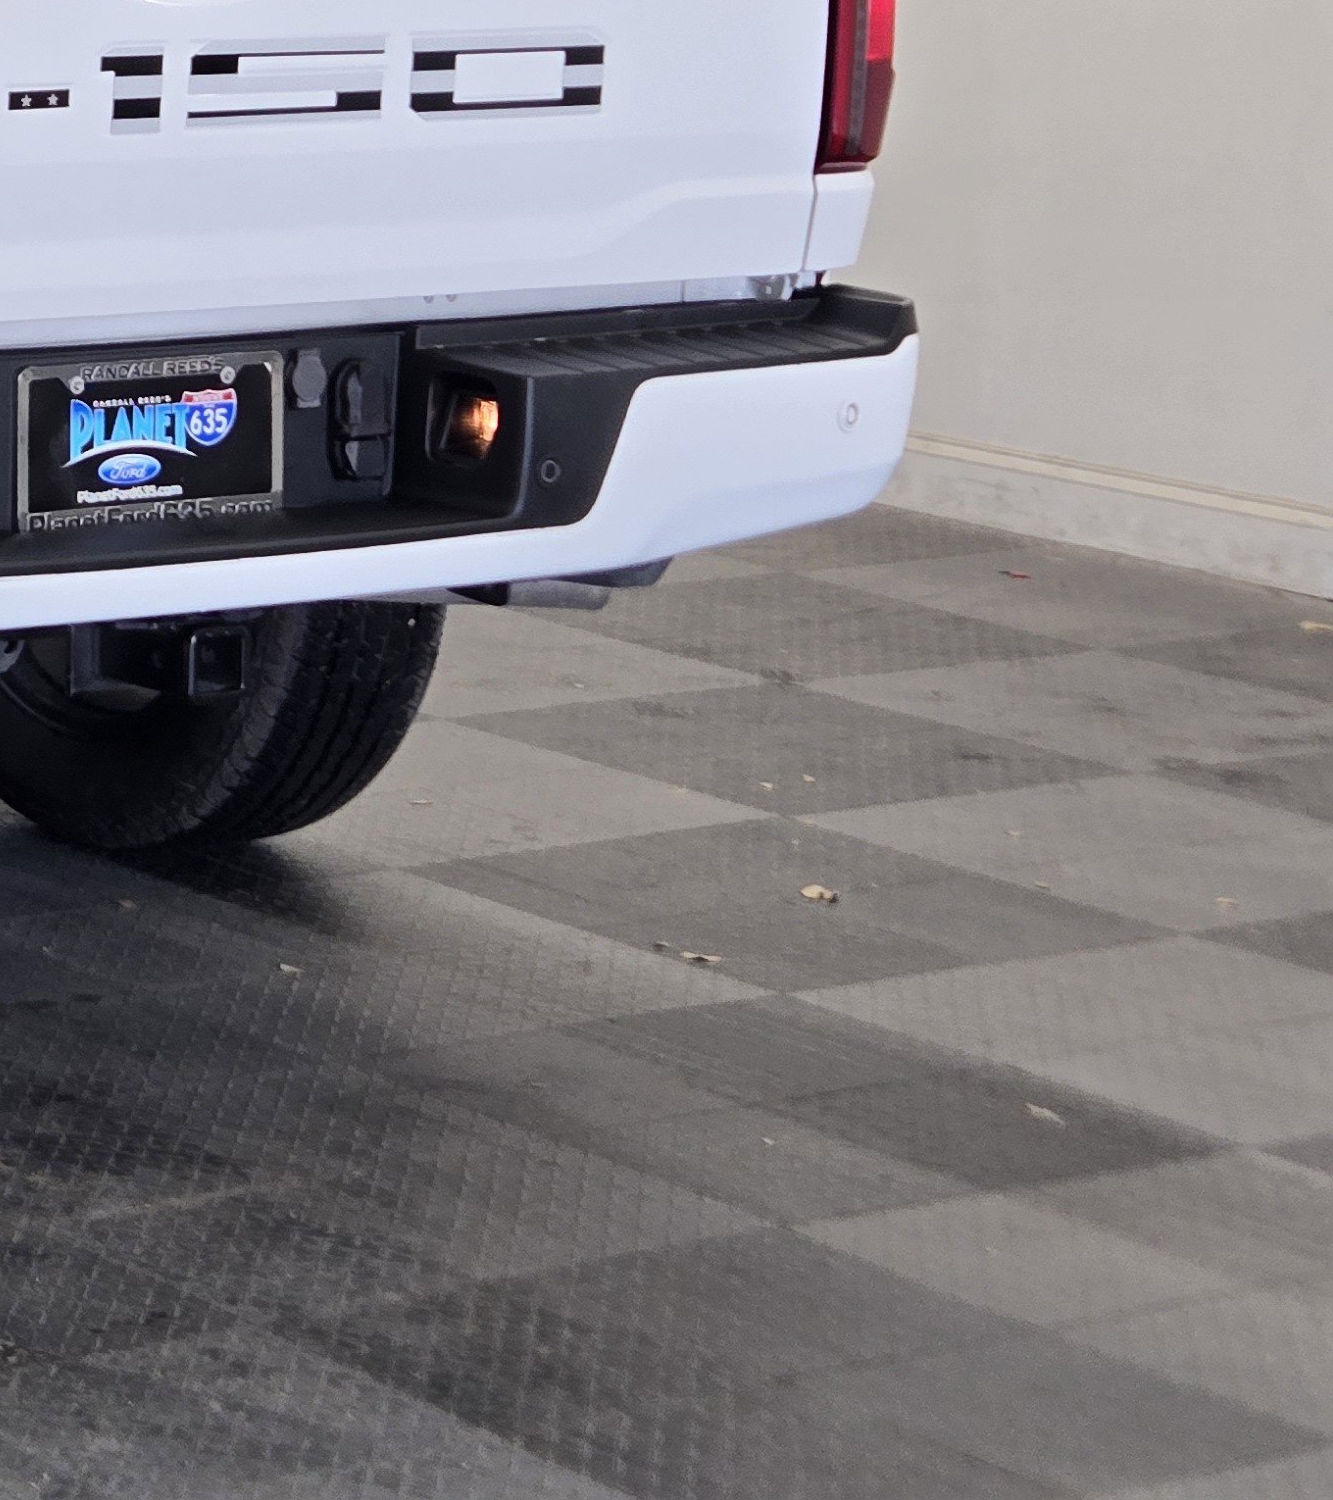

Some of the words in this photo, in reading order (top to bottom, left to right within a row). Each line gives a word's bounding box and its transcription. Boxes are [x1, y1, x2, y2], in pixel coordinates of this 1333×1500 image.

[80, 361, 161, 382] RANDALL
[70, 398, 187, 462] PLANET
[190, 407, 228, 436] 635
[110, 461, 148, 479] Ford
